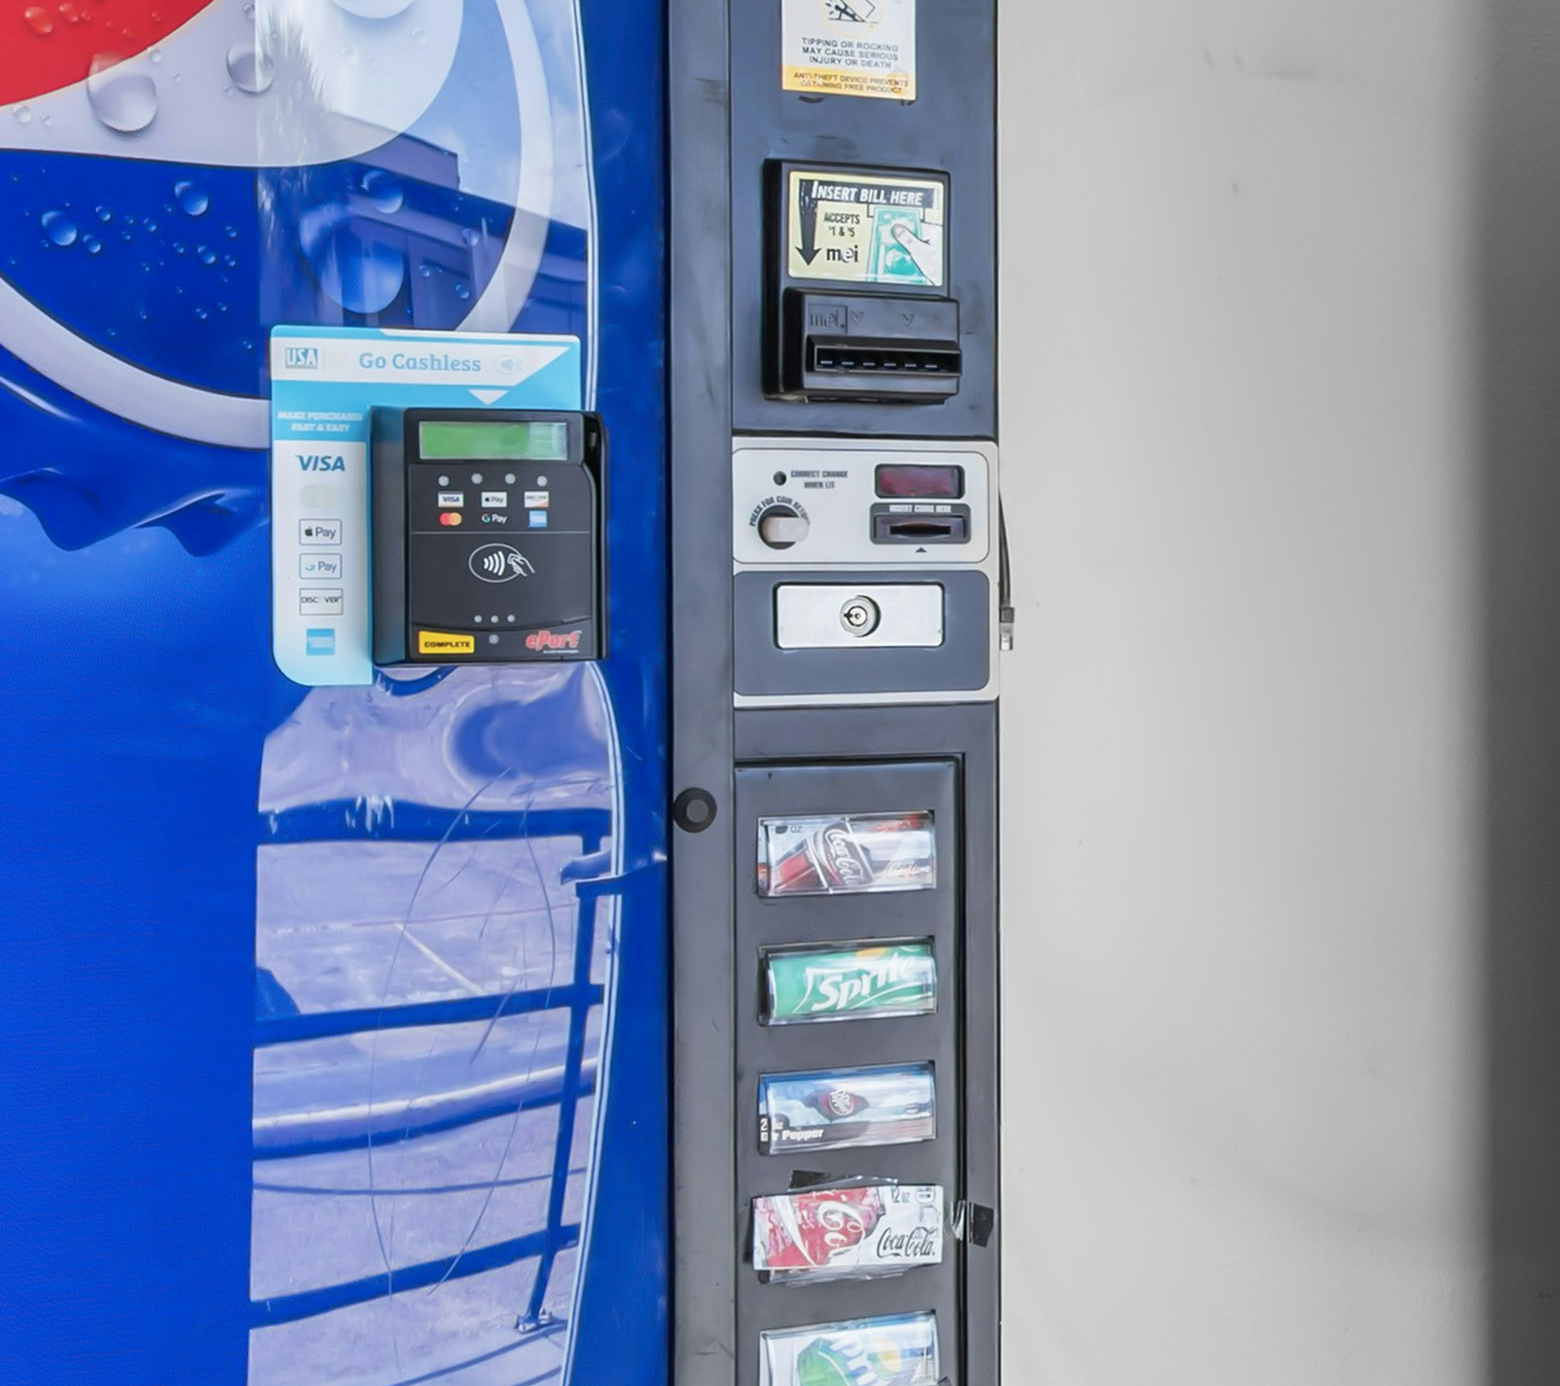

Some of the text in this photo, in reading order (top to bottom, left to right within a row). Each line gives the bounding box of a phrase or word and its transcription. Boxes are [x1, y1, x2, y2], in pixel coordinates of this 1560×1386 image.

[801, 37, 899, 53] TIPPING OR ROCKING
[801, 46, 899, 61] MAY CAUSE SERIOUS
[808, 55, 892, 69] INJURY OR DEATH
[811, 180, 924, 206] INSERT BILL HERE
[823, 212, 860, 225] ACCEPTS
[826, 245, 859, 263] mei
[286, 347, 481, 372] USA Go Cashless
[296, 455, 346, 472] VISA
[491, 513, 508, 525] Pay
[315, 527, 337, 540] Pay
[317, 560, 338, 574] Pay
[423, 641, 471, 649] COMPLETE
[525, 630, 580, 651] ePort
[810, 951, 916, 1011] Sprite
[782, 1128, 824, 1143] Pepper
